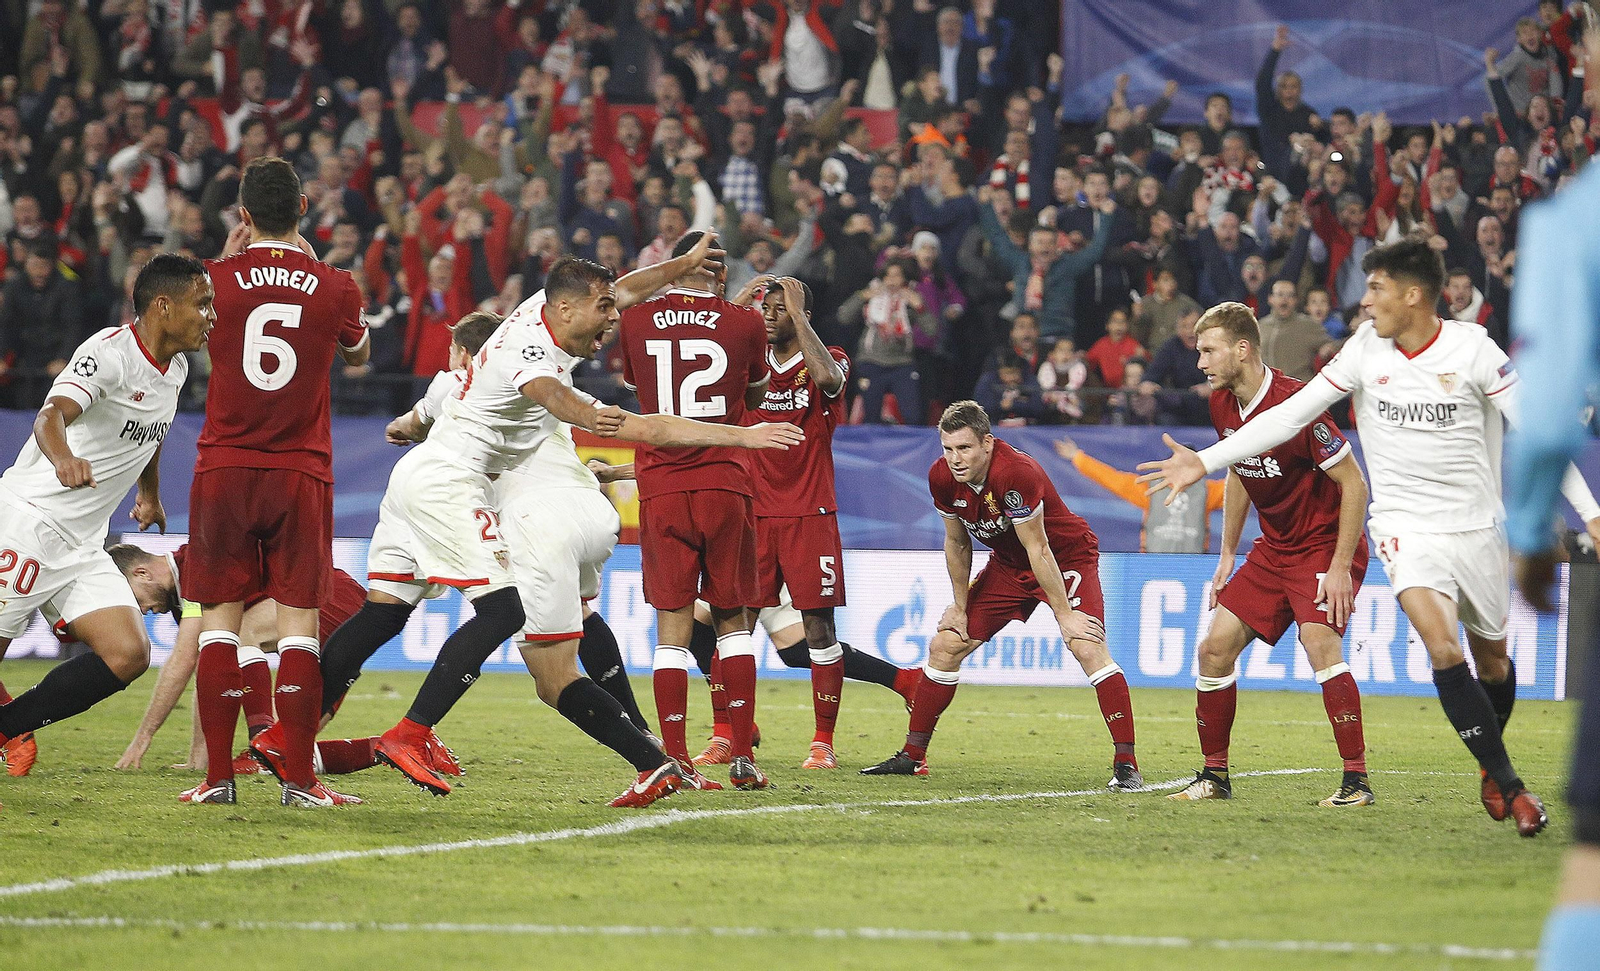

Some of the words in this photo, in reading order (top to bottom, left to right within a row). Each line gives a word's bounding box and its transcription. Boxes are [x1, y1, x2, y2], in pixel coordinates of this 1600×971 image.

[234, 266, 319, 296] LOVREN
[652, 309, 722, 330] GOMEZ
[242, 302, 303, 392] 6
[645, 338, 728, 417] 12
[1378, 400, 1457, 426] PlayWSOP
[1235, 466, 1266, 479] artered
[0, 548, 40, 596] 20
[819, 556, 837, 586] 5
[961, 636, 1063, 670] ZPROM
